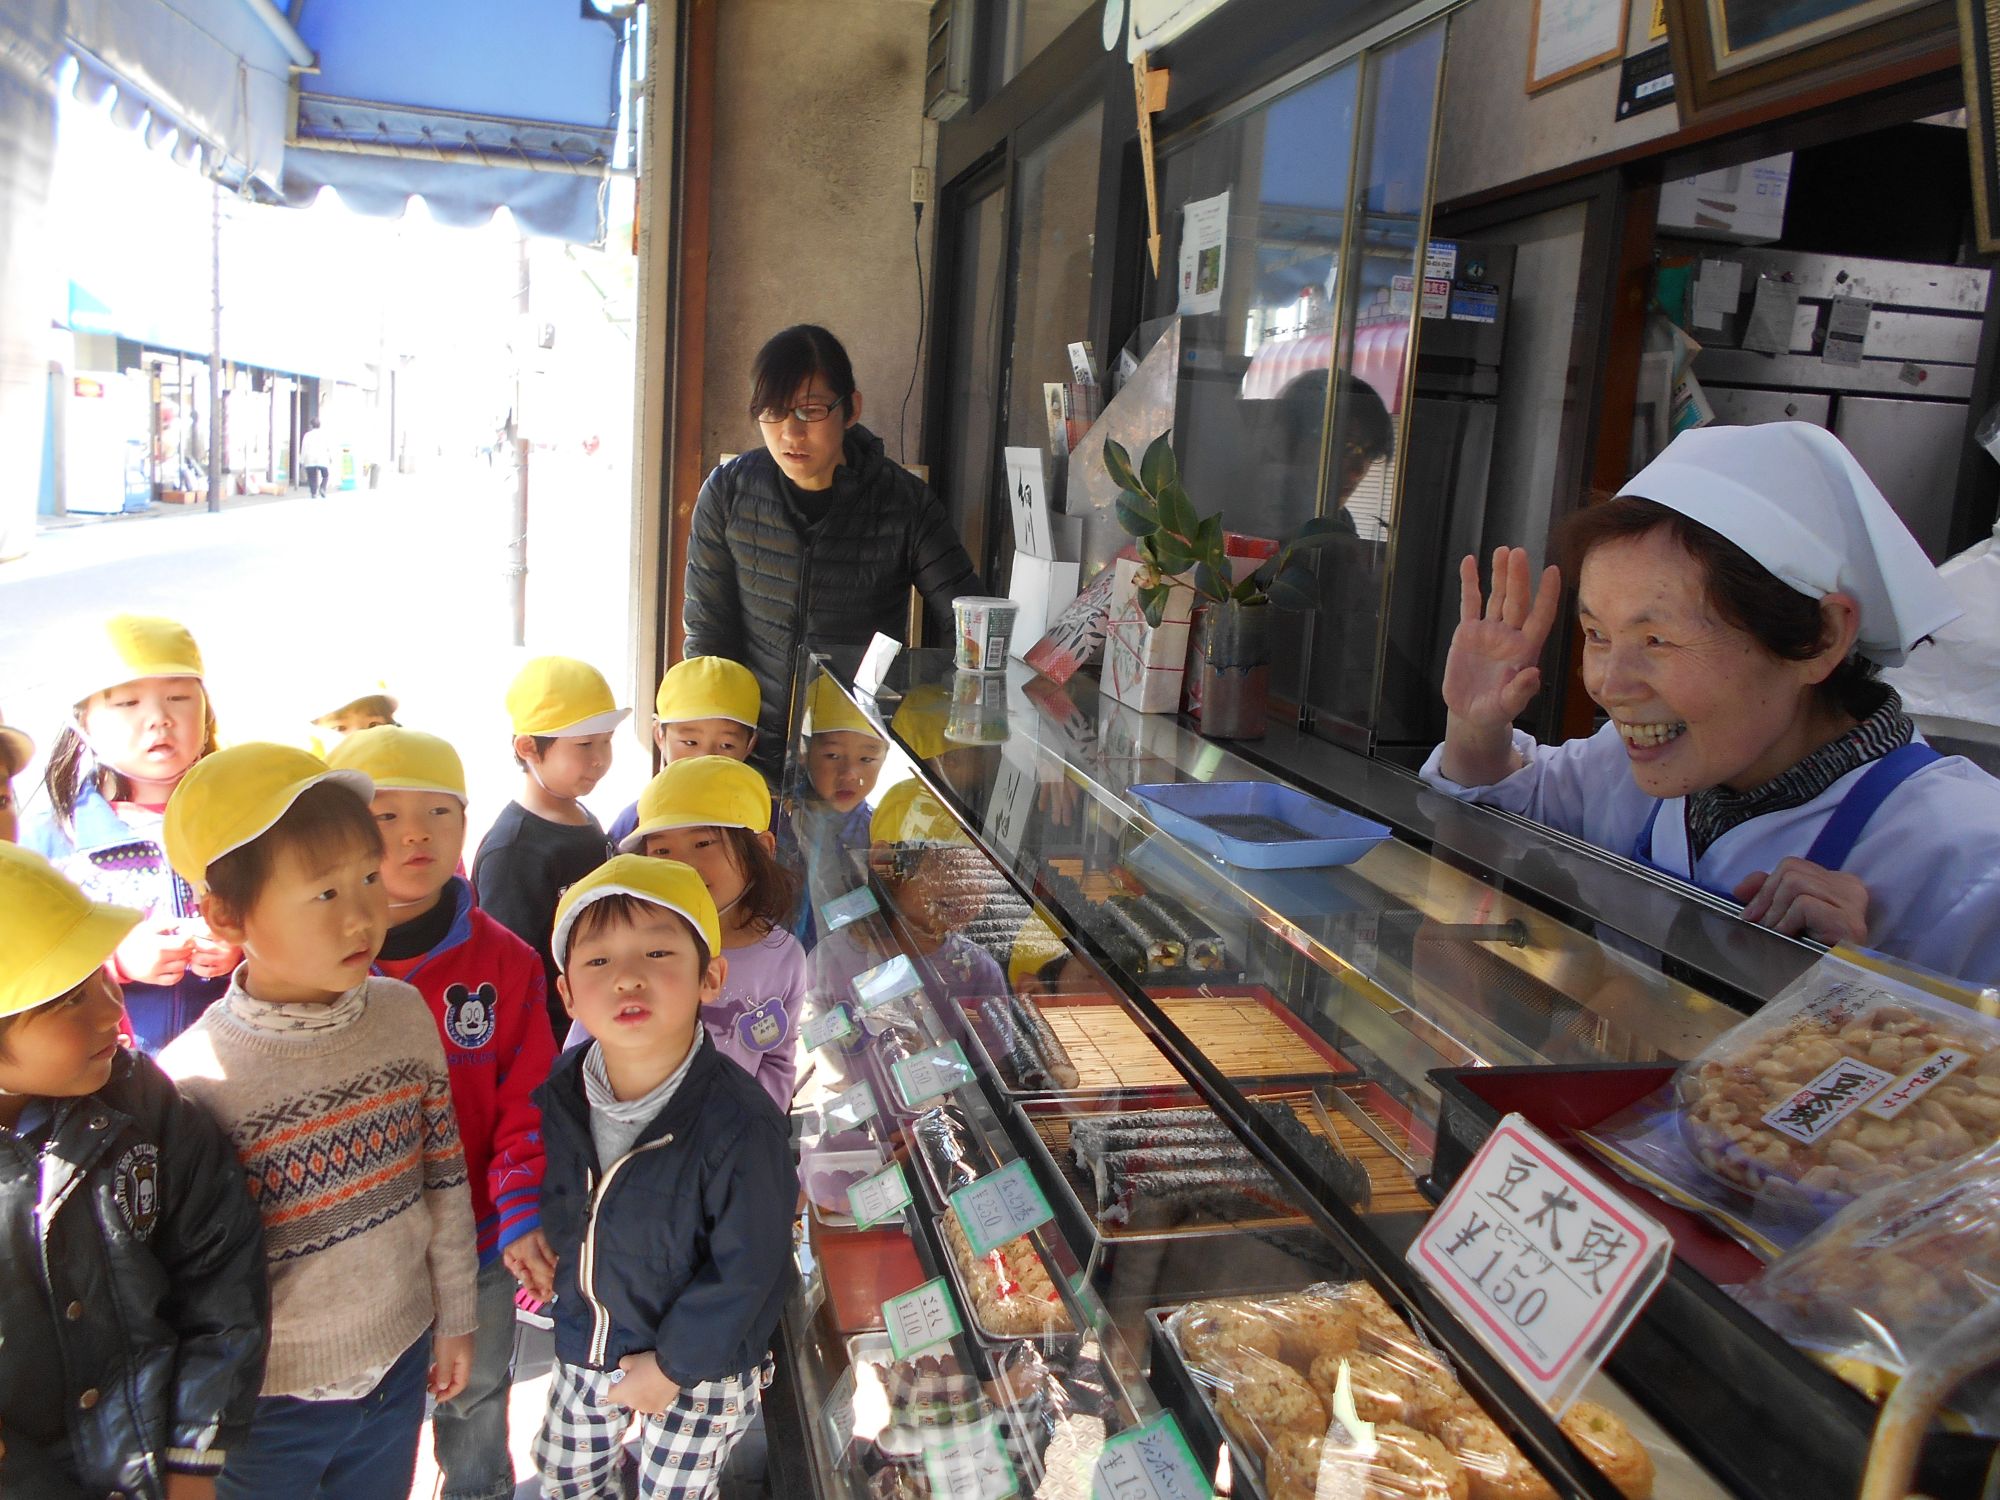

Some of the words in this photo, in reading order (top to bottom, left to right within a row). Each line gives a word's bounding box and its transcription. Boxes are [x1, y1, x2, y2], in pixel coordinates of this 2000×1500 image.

[971, 1189, 1000, 1230] ¥250
[1445, 1211, 1548, 1326] ¥150
[900, 1302, 922, 1337] ¥110
